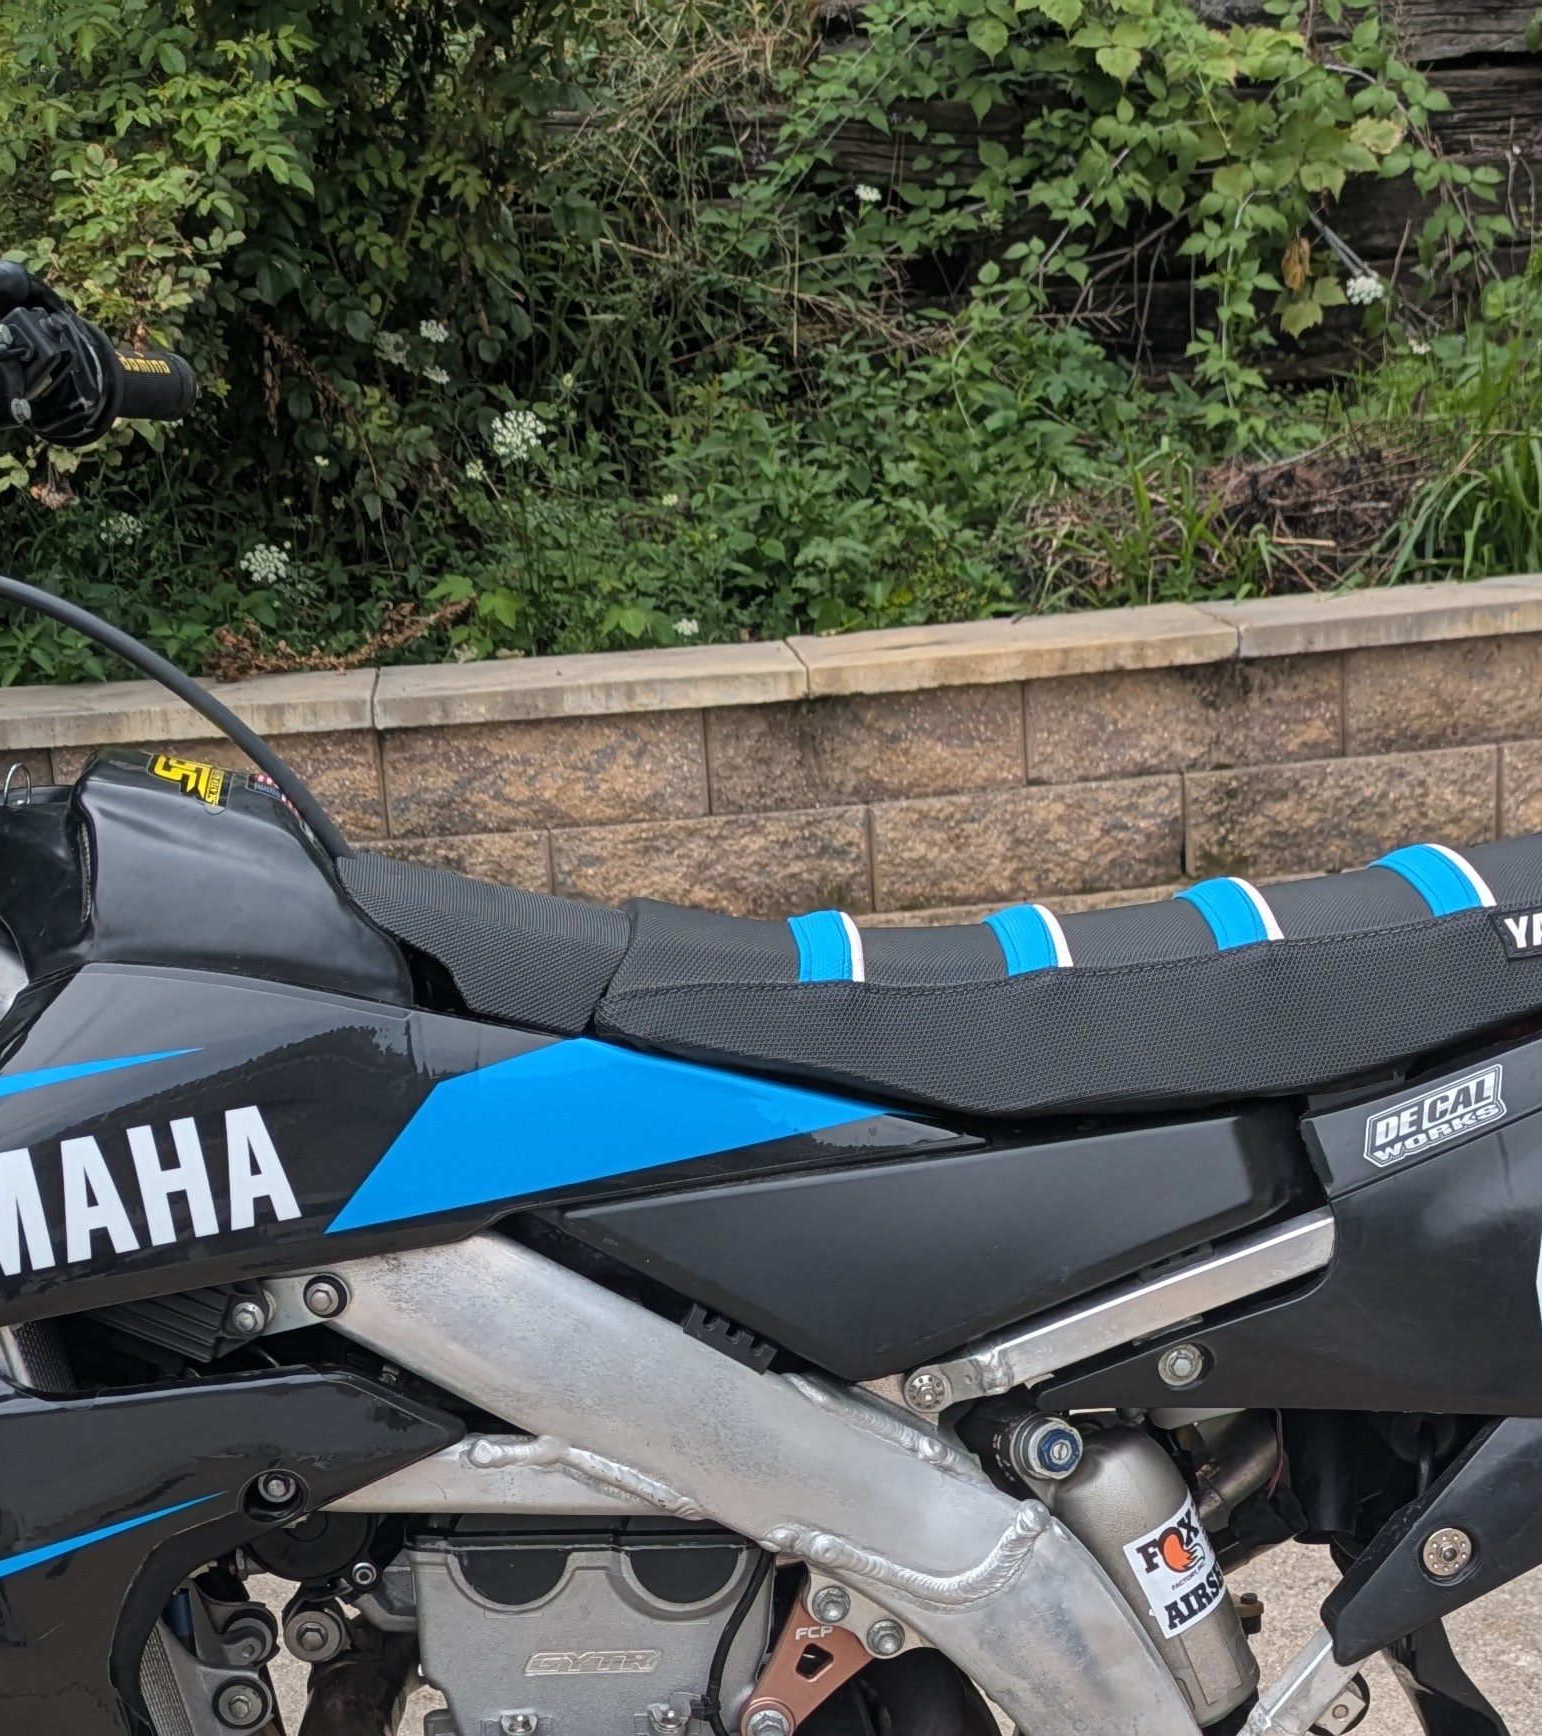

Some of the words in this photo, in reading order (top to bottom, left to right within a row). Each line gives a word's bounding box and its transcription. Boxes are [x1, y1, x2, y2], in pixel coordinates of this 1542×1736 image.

[1373, 1103, 1500, 1161] WORKS
[1136, 1508, 1203, 1574] FOX
[795, 1626, 834, 1640] FCP
[525, 1650, 661, 1676] GYTR
